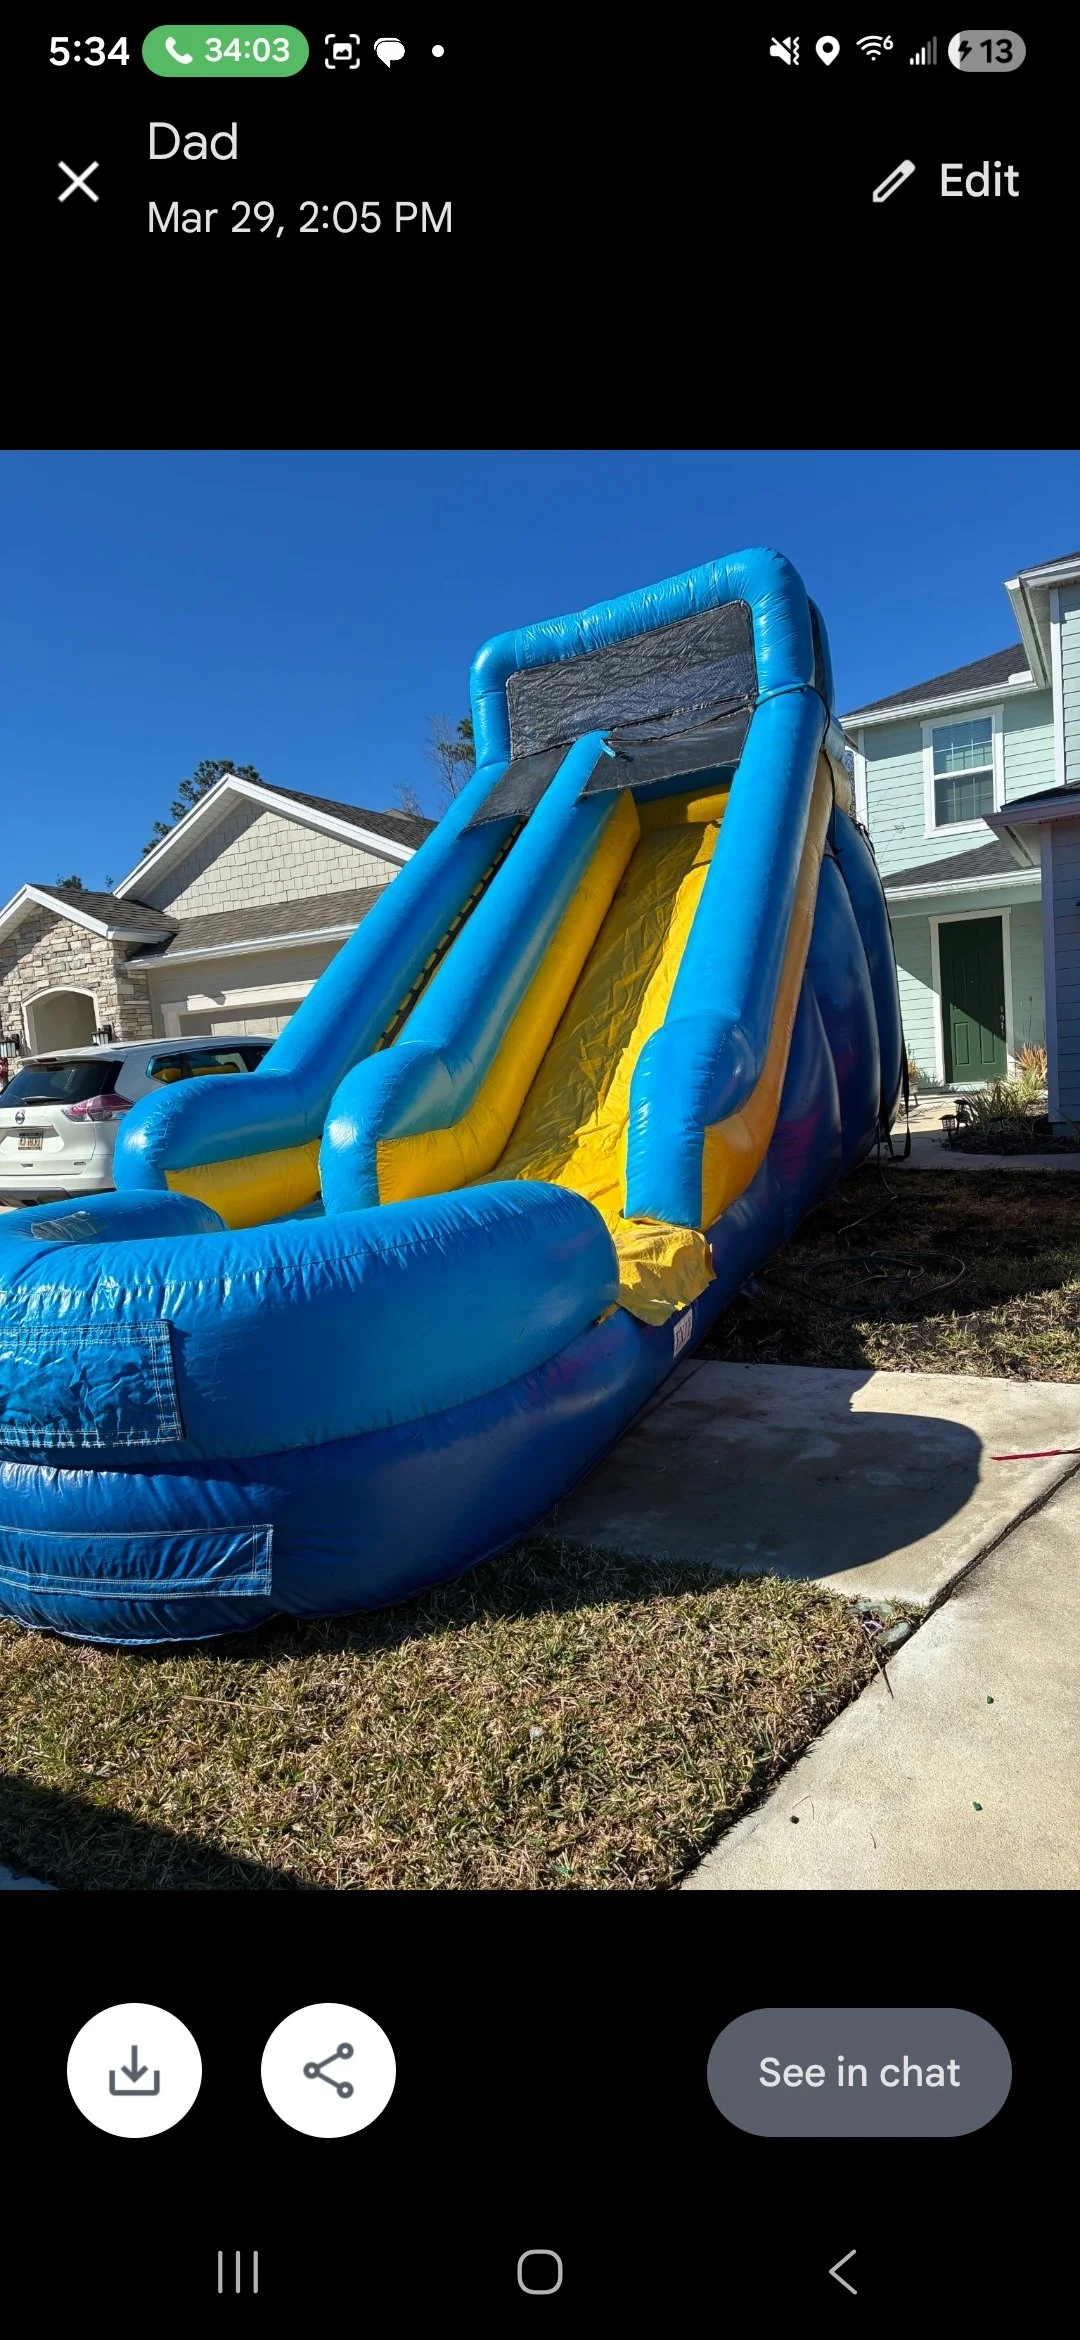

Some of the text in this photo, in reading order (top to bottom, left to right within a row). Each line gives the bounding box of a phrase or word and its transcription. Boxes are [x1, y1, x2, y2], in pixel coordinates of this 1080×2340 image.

[49, 36, 130, 66] 5:34
[204, 37, 290, 63] 34:03
[979, 38, 1014, 64] 13
[149, 121, 238, 161] Dad
[941, 160, 1020, 198] Edit
[148, 200, 452, 238] Mar 29, 2:05 PM
[759, 2054, 961, 2088] See in chat
